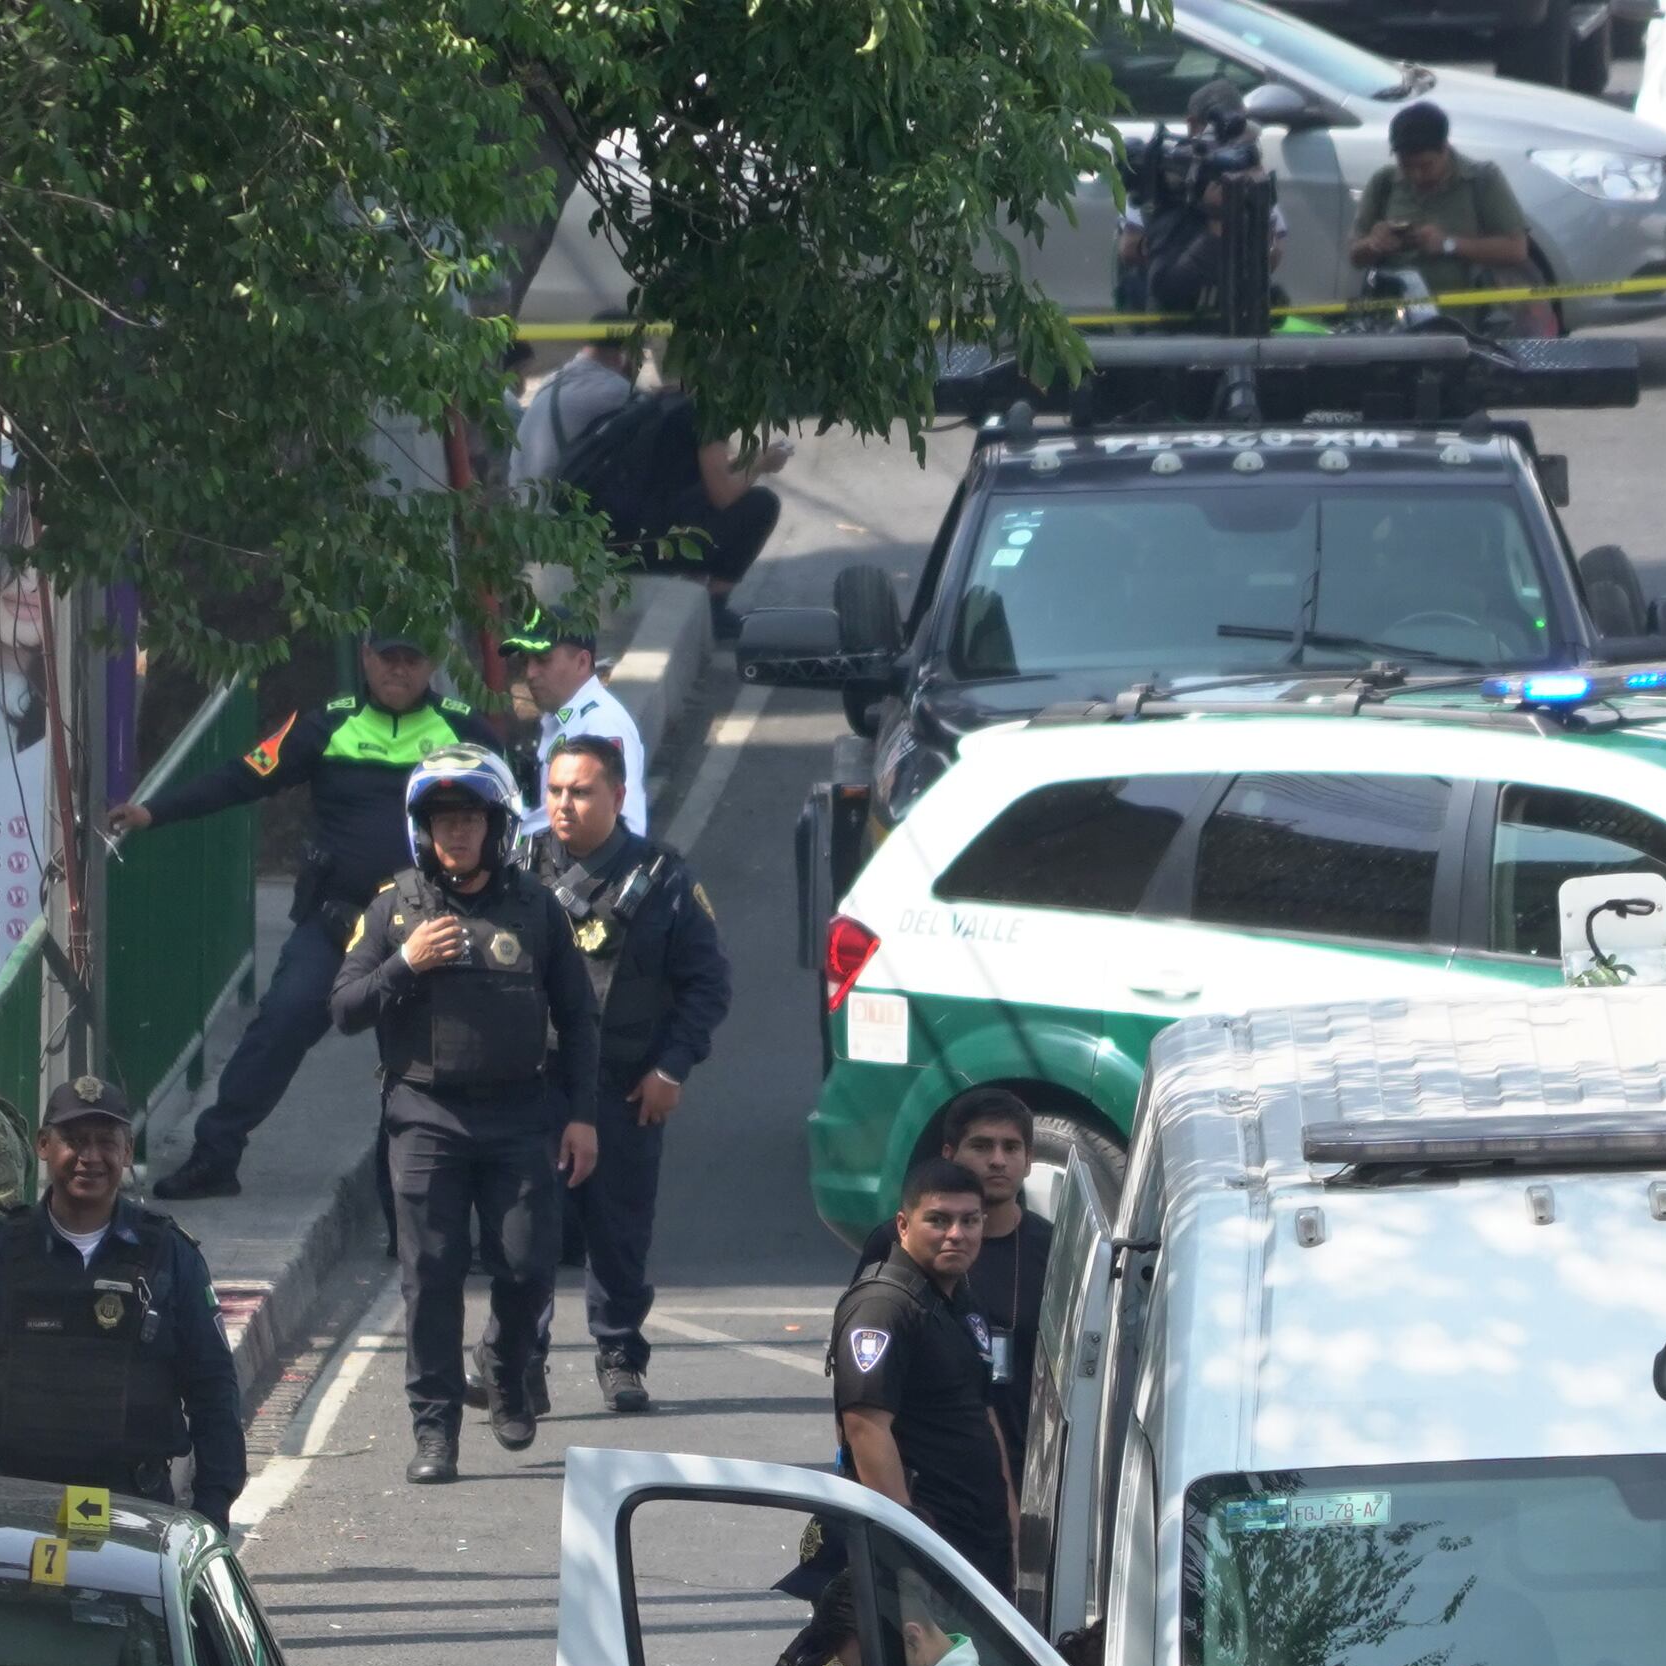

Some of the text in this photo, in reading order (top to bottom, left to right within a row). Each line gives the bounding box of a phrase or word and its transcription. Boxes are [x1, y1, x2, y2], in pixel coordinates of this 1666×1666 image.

[898, 909, 1023, 943] DEL VALLE
[1294, 1501, 1382, 1521] FGJ-78-A7
[45, 1544, 57, 1574] 7
